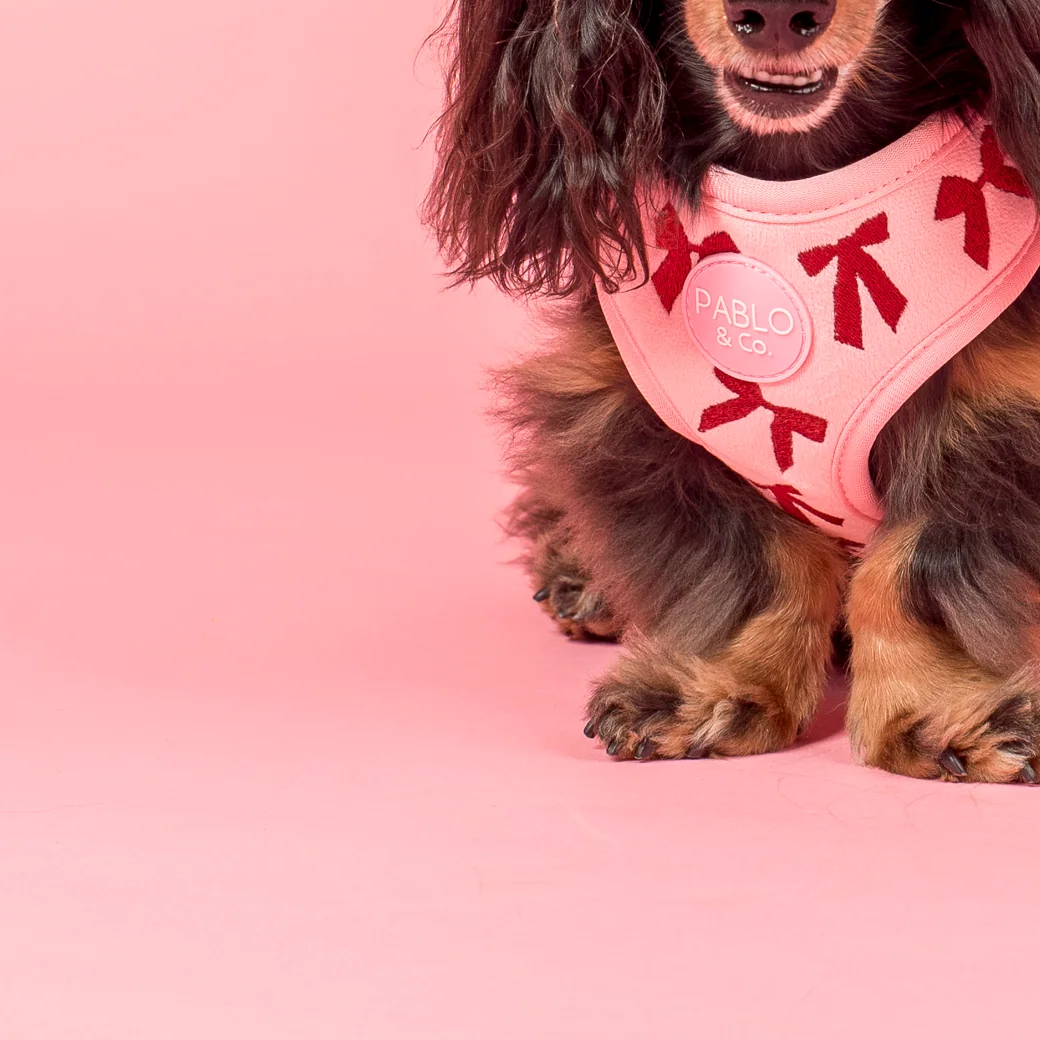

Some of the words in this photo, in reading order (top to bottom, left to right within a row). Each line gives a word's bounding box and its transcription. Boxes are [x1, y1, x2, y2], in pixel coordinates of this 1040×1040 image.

[695, 287, 794, 335] PABLO
[716, 326, 732, 347] &
[738, 332, 773, 356] Co.
